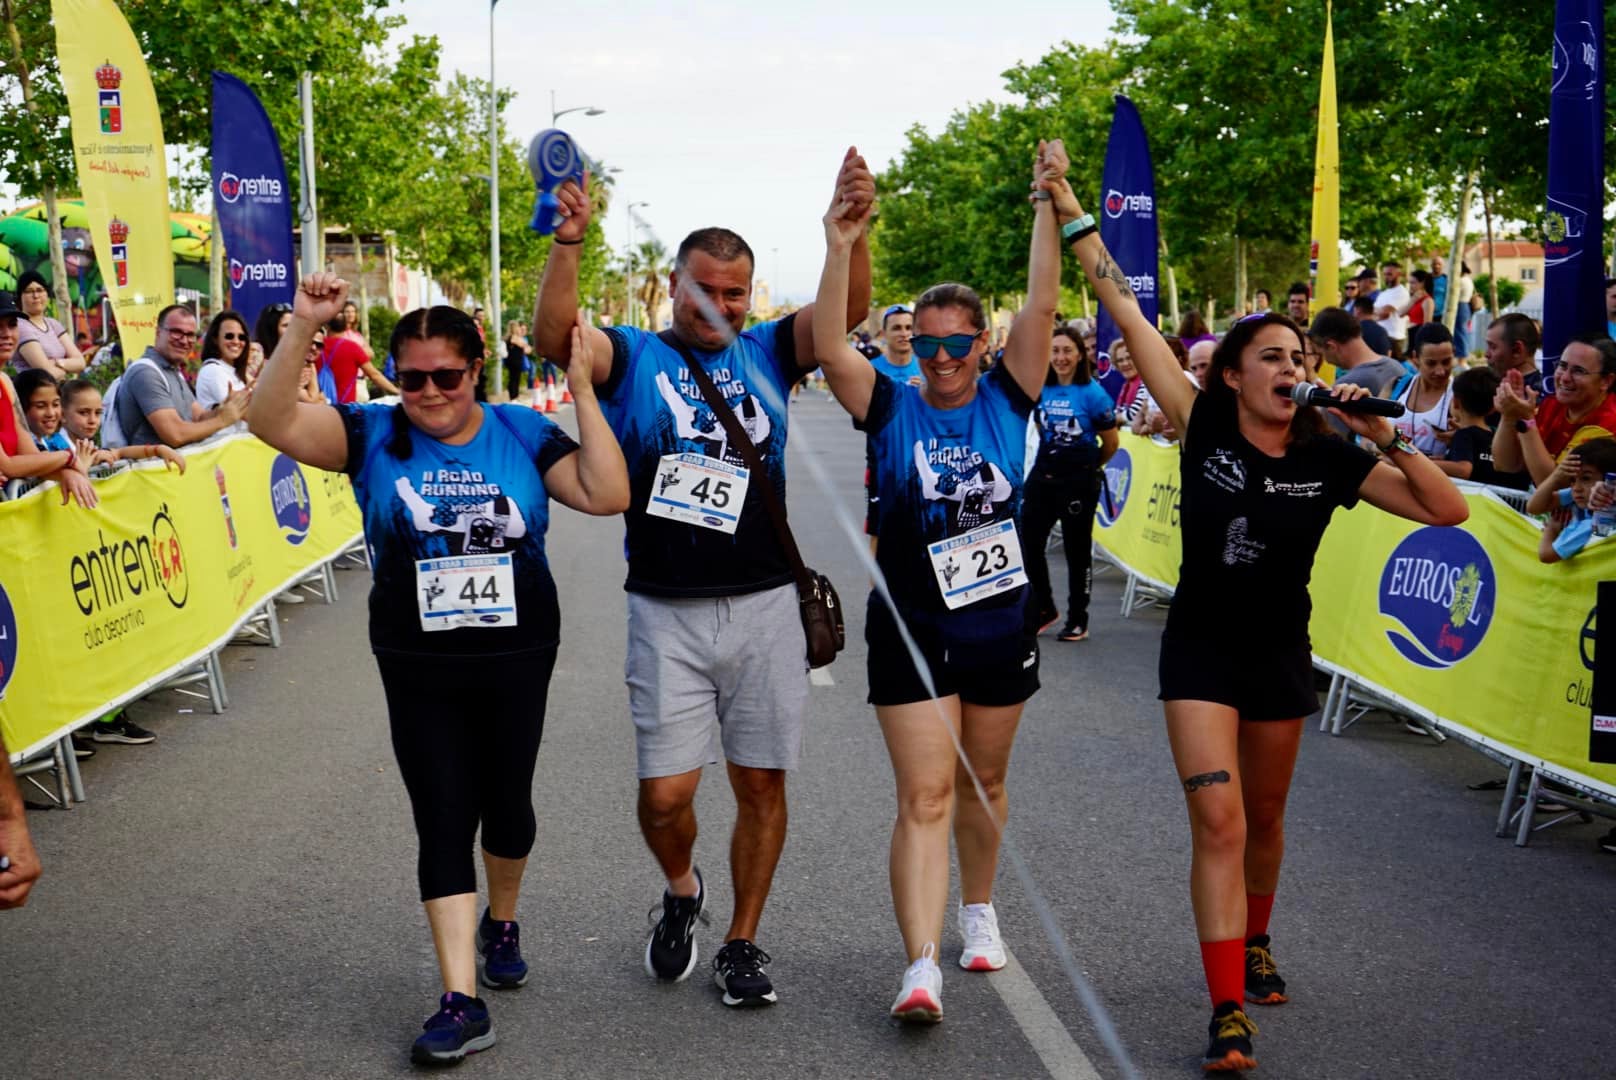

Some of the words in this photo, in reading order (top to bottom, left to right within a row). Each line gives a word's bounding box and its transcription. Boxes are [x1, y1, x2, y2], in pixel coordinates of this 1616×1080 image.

[421, 483, 500, 497] RUNNING
[422, 471, 434, 482] II
[437, 469, 483, 483] ROAD
[690, 477, 732, 508] 45
[70, 528, 159, 617] entren
[971, 544, 1009, 578] 23
[459, 575, 500, 605] 44
[84, 622, 104, 650] club
[103, 608, 145, 642] deportivo
